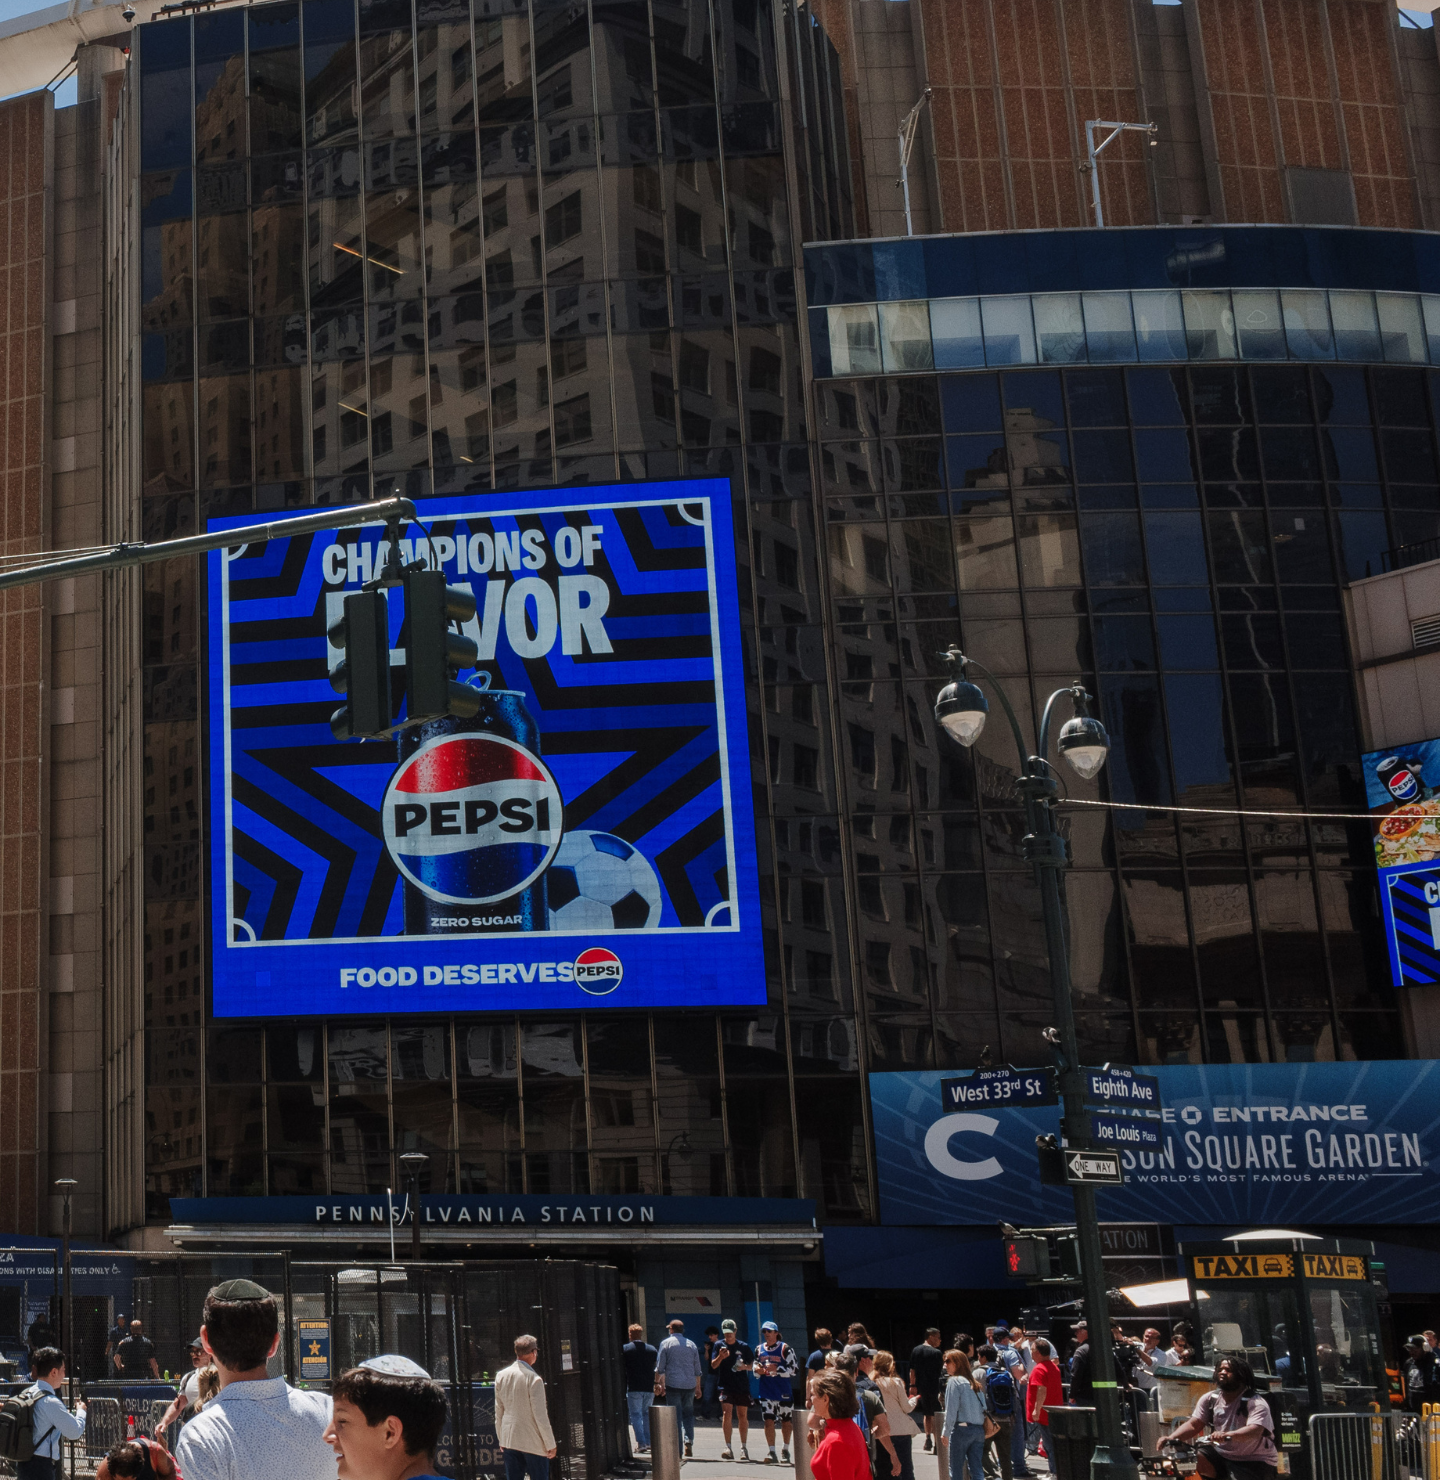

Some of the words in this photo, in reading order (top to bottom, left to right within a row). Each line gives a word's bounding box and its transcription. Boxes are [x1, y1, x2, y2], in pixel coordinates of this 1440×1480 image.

[322, 529, 547, 584] CHAMPIONS
[554, 525, 604, 568] OF
[394, 797, 550, 837] PEPSI
[430, 917, 470, 927] ZERO
[472, 915, 522, 926] SUGAR
[340, 967, 418, 988] FOOD
[423, 962, 575, 986] DESERVES
[576, 965, 620, 977] PEPSI
[980, 1072, 993, 1080] 200
[996, 1070, 1009, 1078] 270
[951, 1084, 990, 1102] West
[994, 1079, 1021, 1099] 33rd
[1025, 1079, 1042, 1096] St
[1092, 1077, 1128, 1099] Eighth
[1131, 1082, 1153, 1100] Ave
[1213, 1105, 1368, 1122] ENTRANCE
[1098, 1122, 1114, 1139] Joe
[1116, 1122, 1140, 1142] Louis
[1142, 1131, 1157, 1142] Plaza
[924, 1113, 1004, 1181] C
[1074, 1160, 1090, 1172] ONE
[1095, 1162, 1112, 1173] WAY
[1207, 1174, 1245, 1182] MOST
[1253, 1174, 1311, 1182] FAMOUS
[1318, 1173, 1367, 1181] ARENA
[541, 1206, 654, 1222] STATION
[16, 1267, 35, 1275] WITH
[89, 1267, 110, 1275] ONLY
[1198, 1256, 1259, 1277] TAXI
[1305, 1256, 1344, 1277] TAXI
